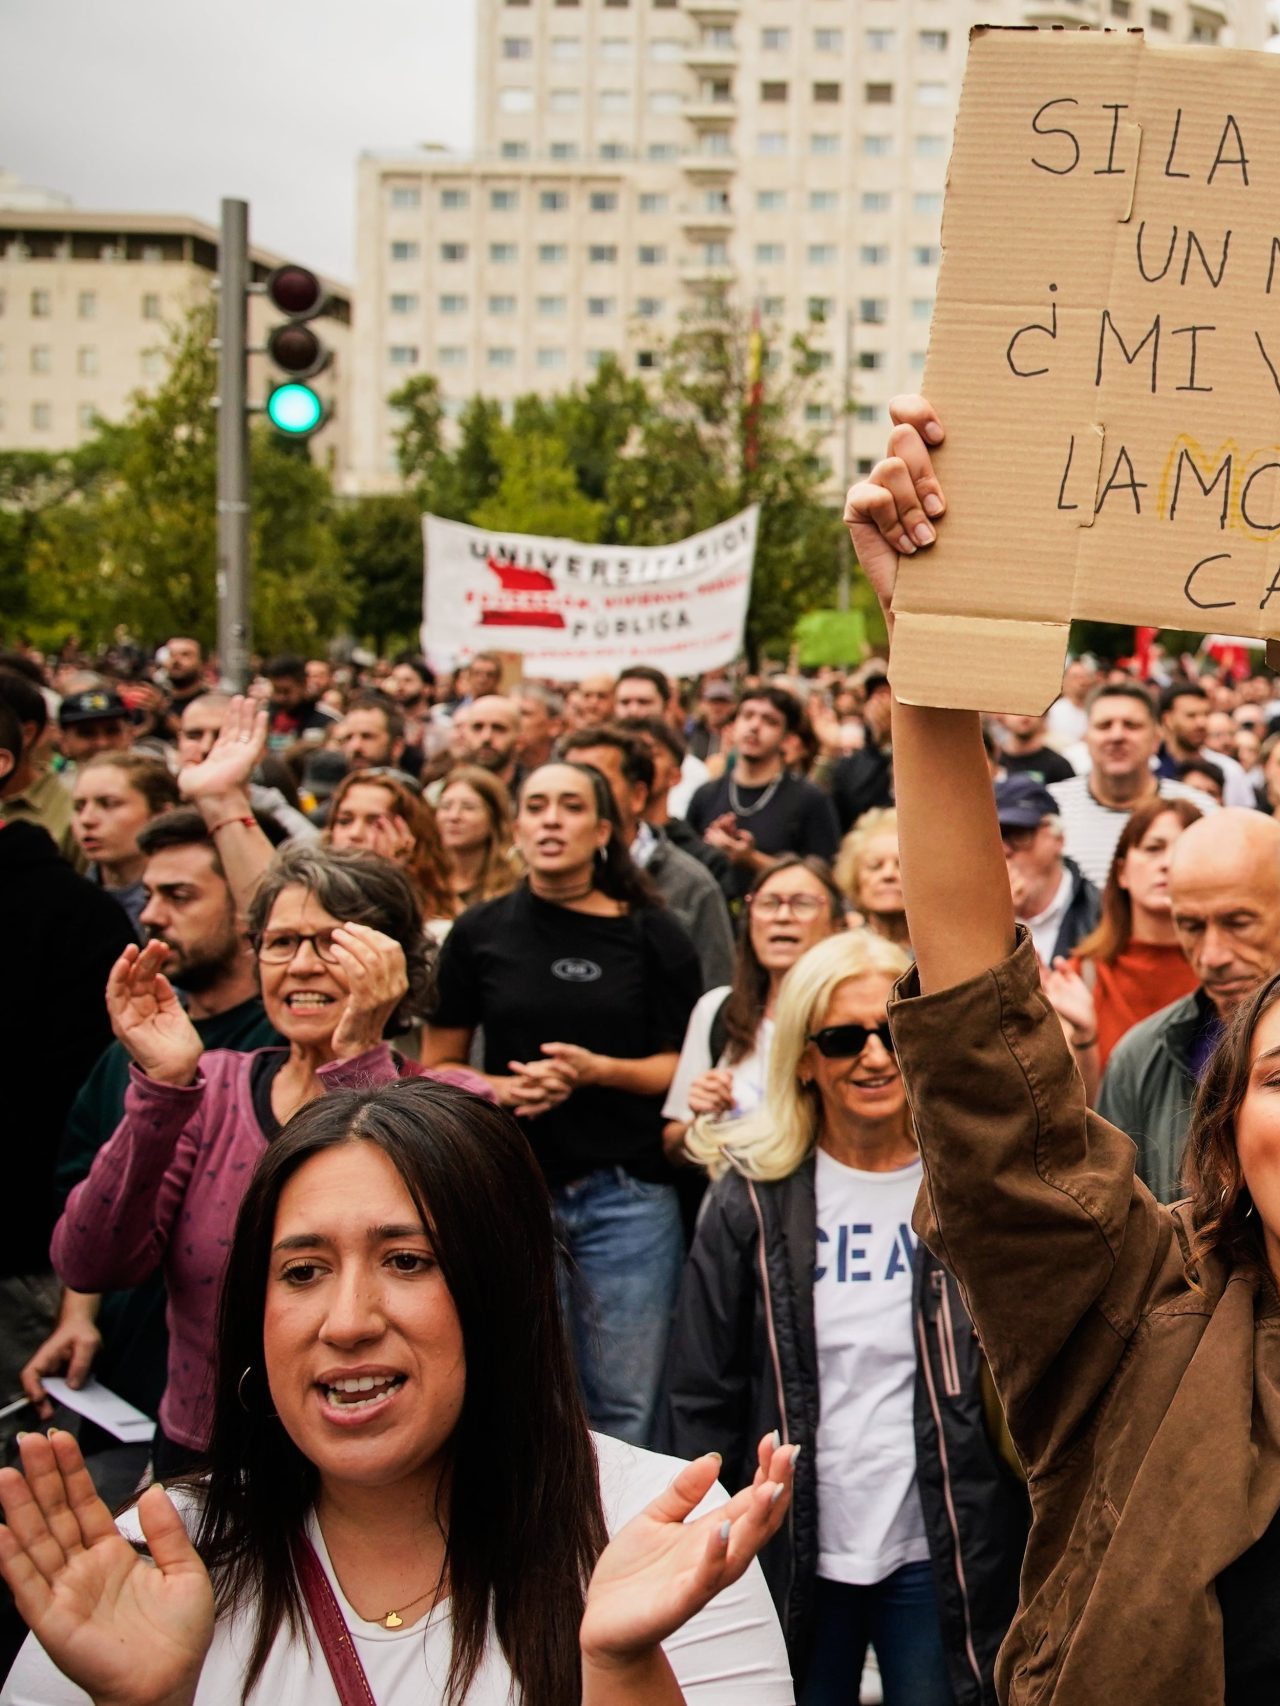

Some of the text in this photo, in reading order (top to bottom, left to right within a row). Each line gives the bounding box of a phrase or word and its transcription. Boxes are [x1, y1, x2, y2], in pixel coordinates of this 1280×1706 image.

[1031, 98, 1130, 176] SI
[1164, 107, 1250, 187] LA
[1136, 221, 1232, 288] UN
[1056, 435, 1147, 515] LA
